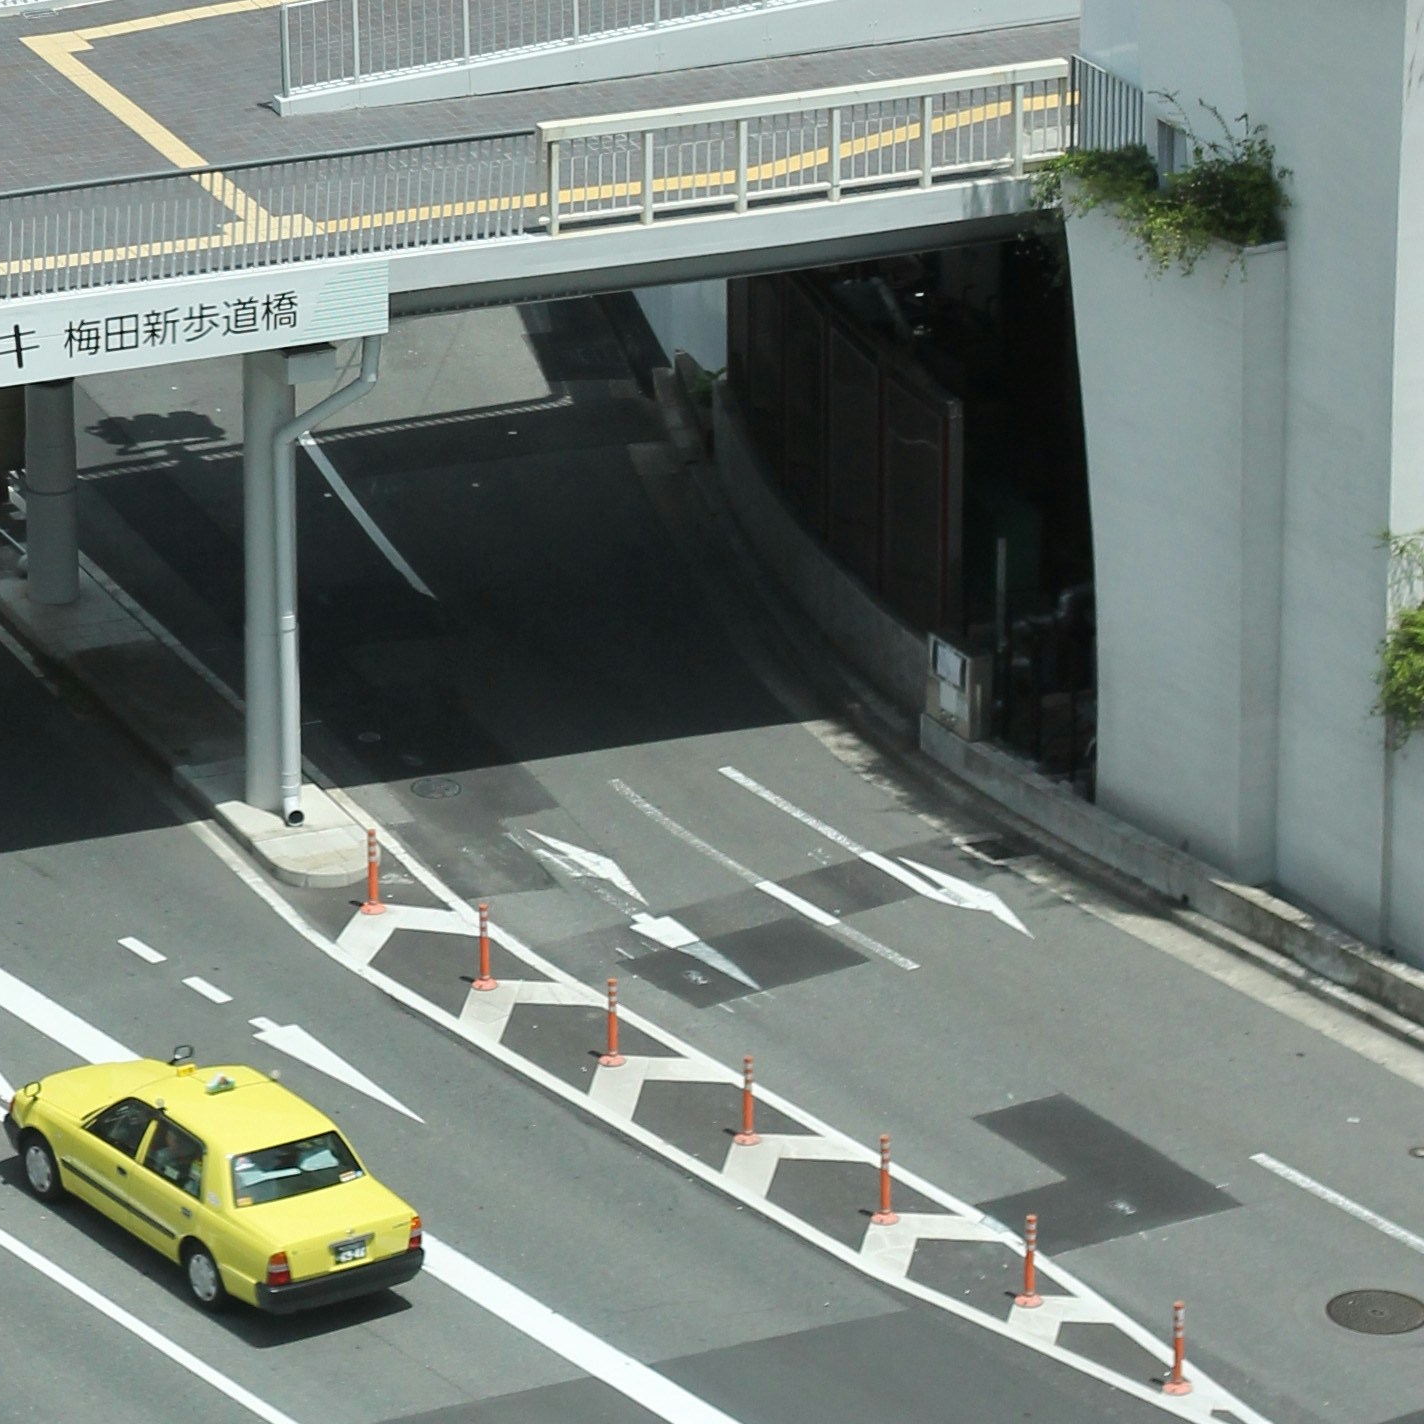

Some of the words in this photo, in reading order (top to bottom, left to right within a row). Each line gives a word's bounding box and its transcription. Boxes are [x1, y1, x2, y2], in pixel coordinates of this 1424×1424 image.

[63, 289, 300, 360] 梅田新歩道橋
